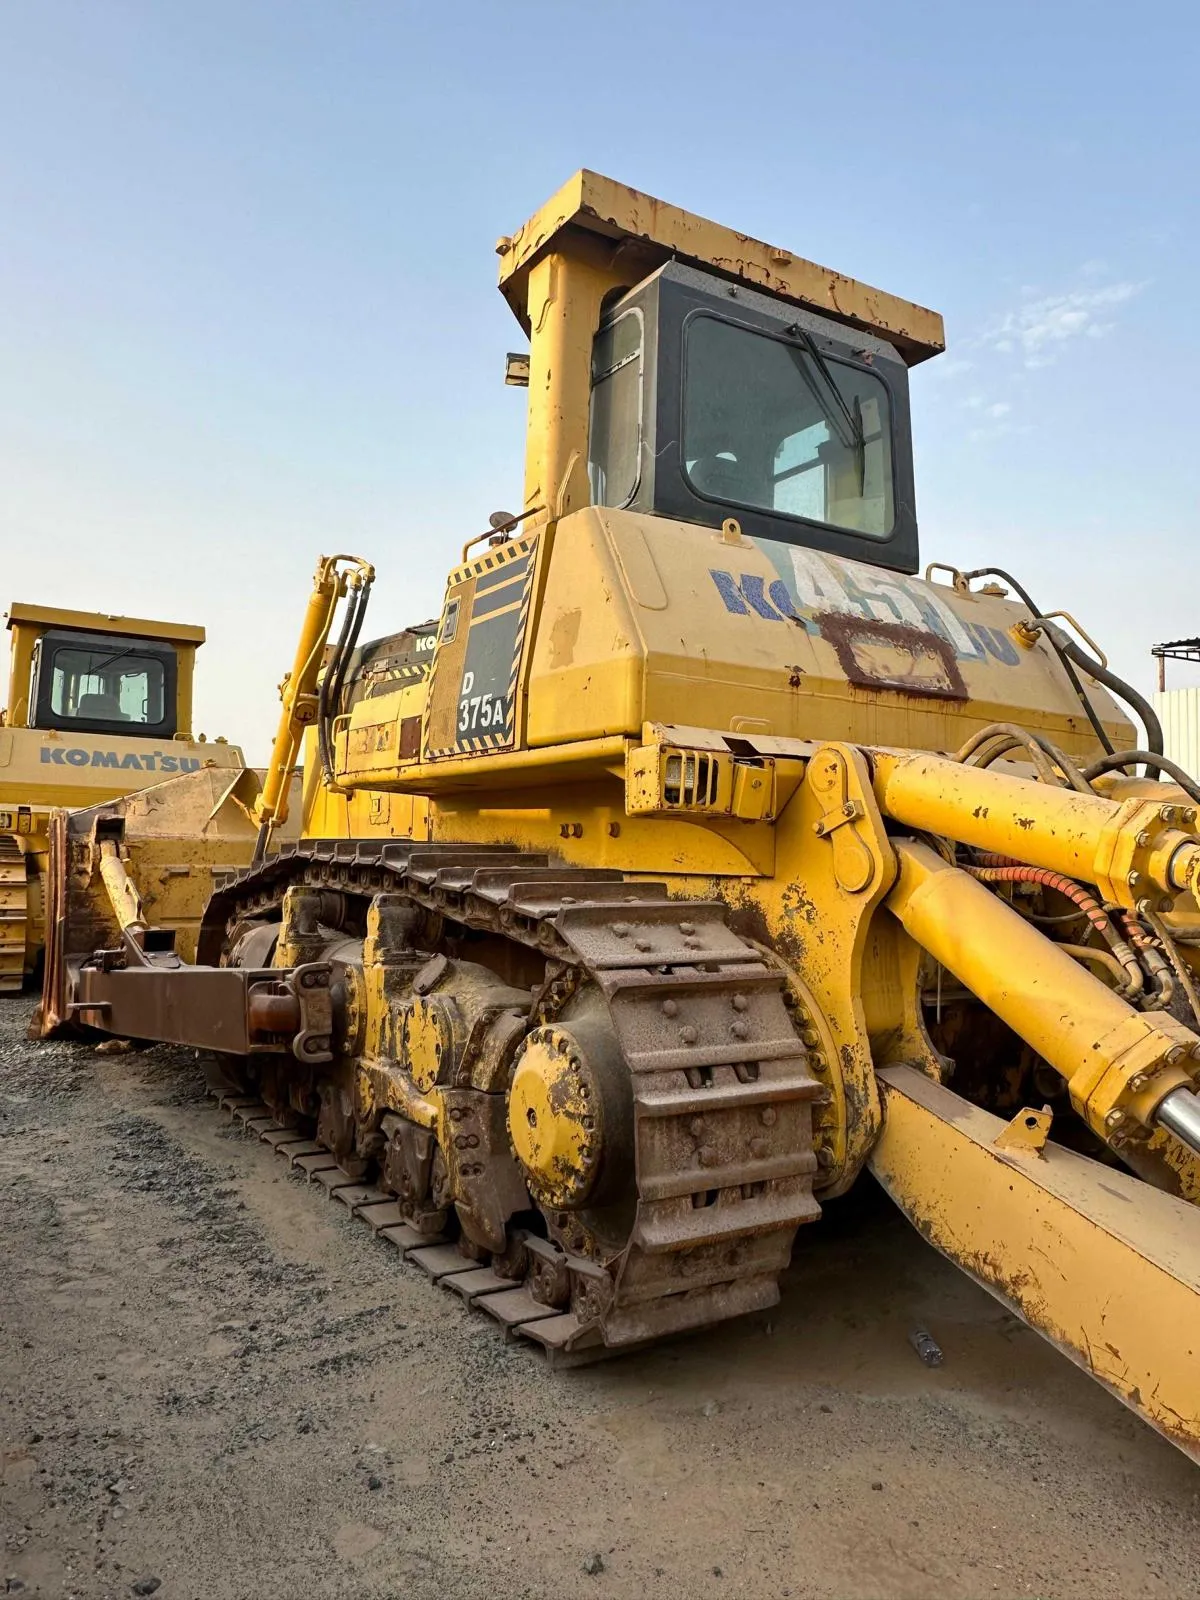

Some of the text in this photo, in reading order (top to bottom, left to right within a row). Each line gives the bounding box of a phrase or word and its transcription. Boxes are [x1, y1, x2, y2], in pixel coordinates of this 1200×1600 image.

[461, 671, 474, 695] D
[459, 693, 504, 731] 375A
[40, 747, 200, 773] KOMATSU
